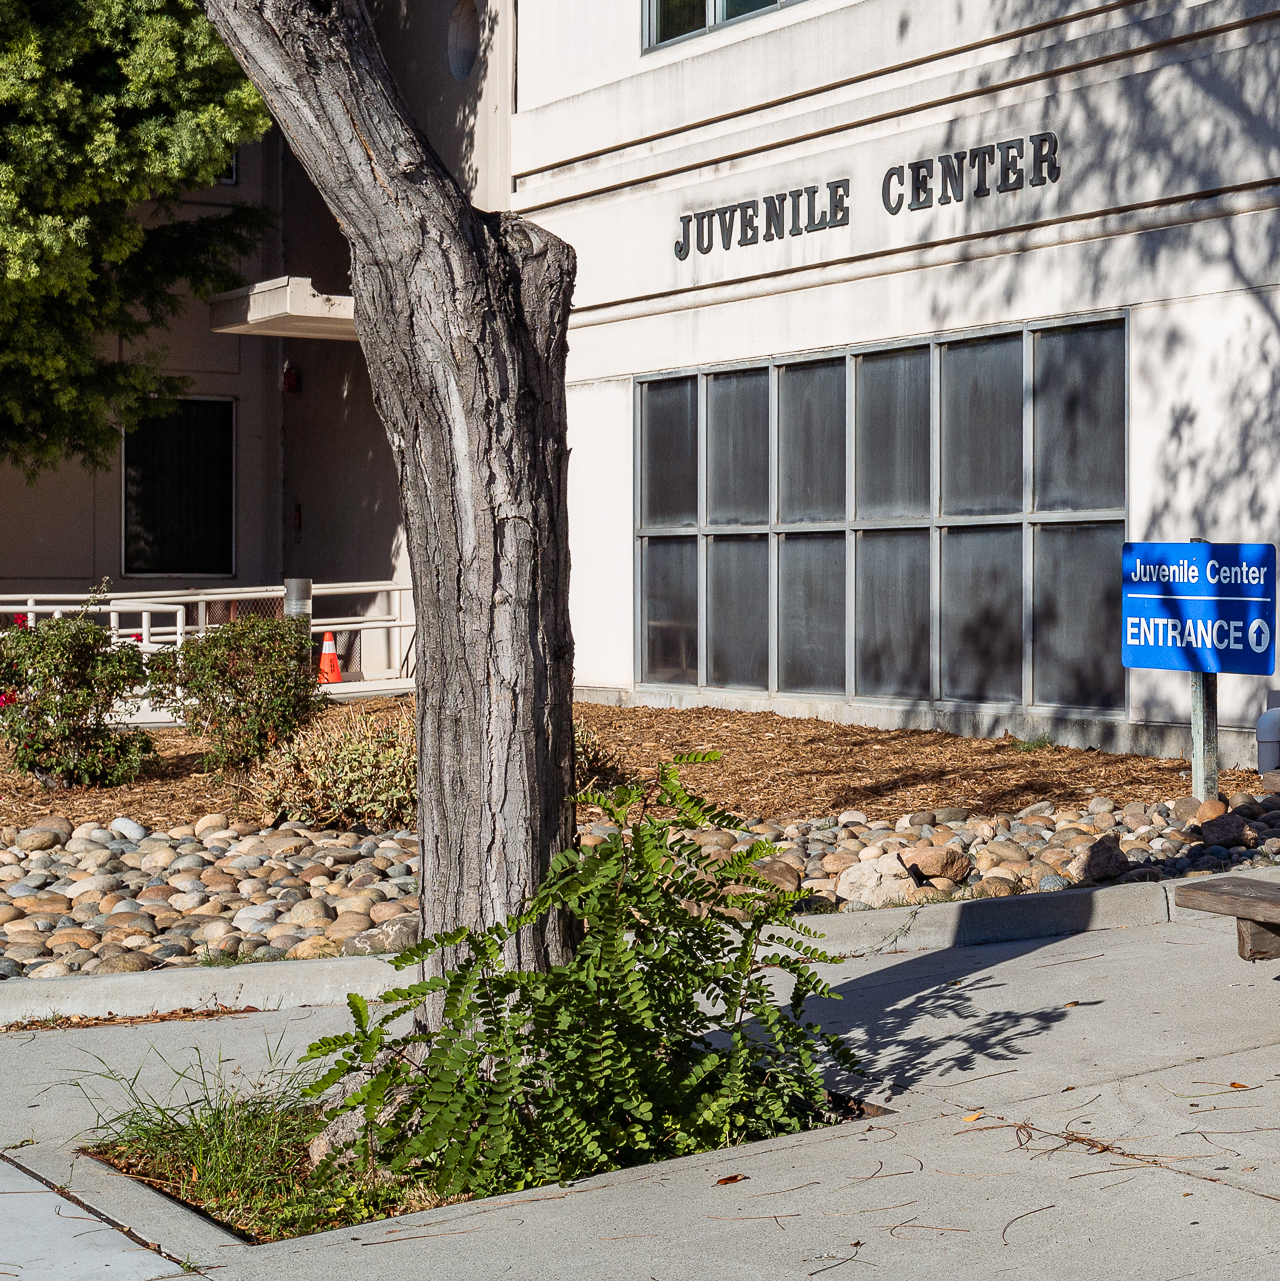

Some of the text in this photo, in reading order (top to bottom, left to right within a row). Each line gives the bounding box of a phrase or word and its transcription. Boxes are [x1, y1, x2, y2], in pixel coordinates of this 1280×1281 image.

[674, 131, 1061, 261] JUVENILE CENTER
[1131, 558, 1267, 585] Juvenile Center
[1126, 617, 1244, 650] ENTRANCE
